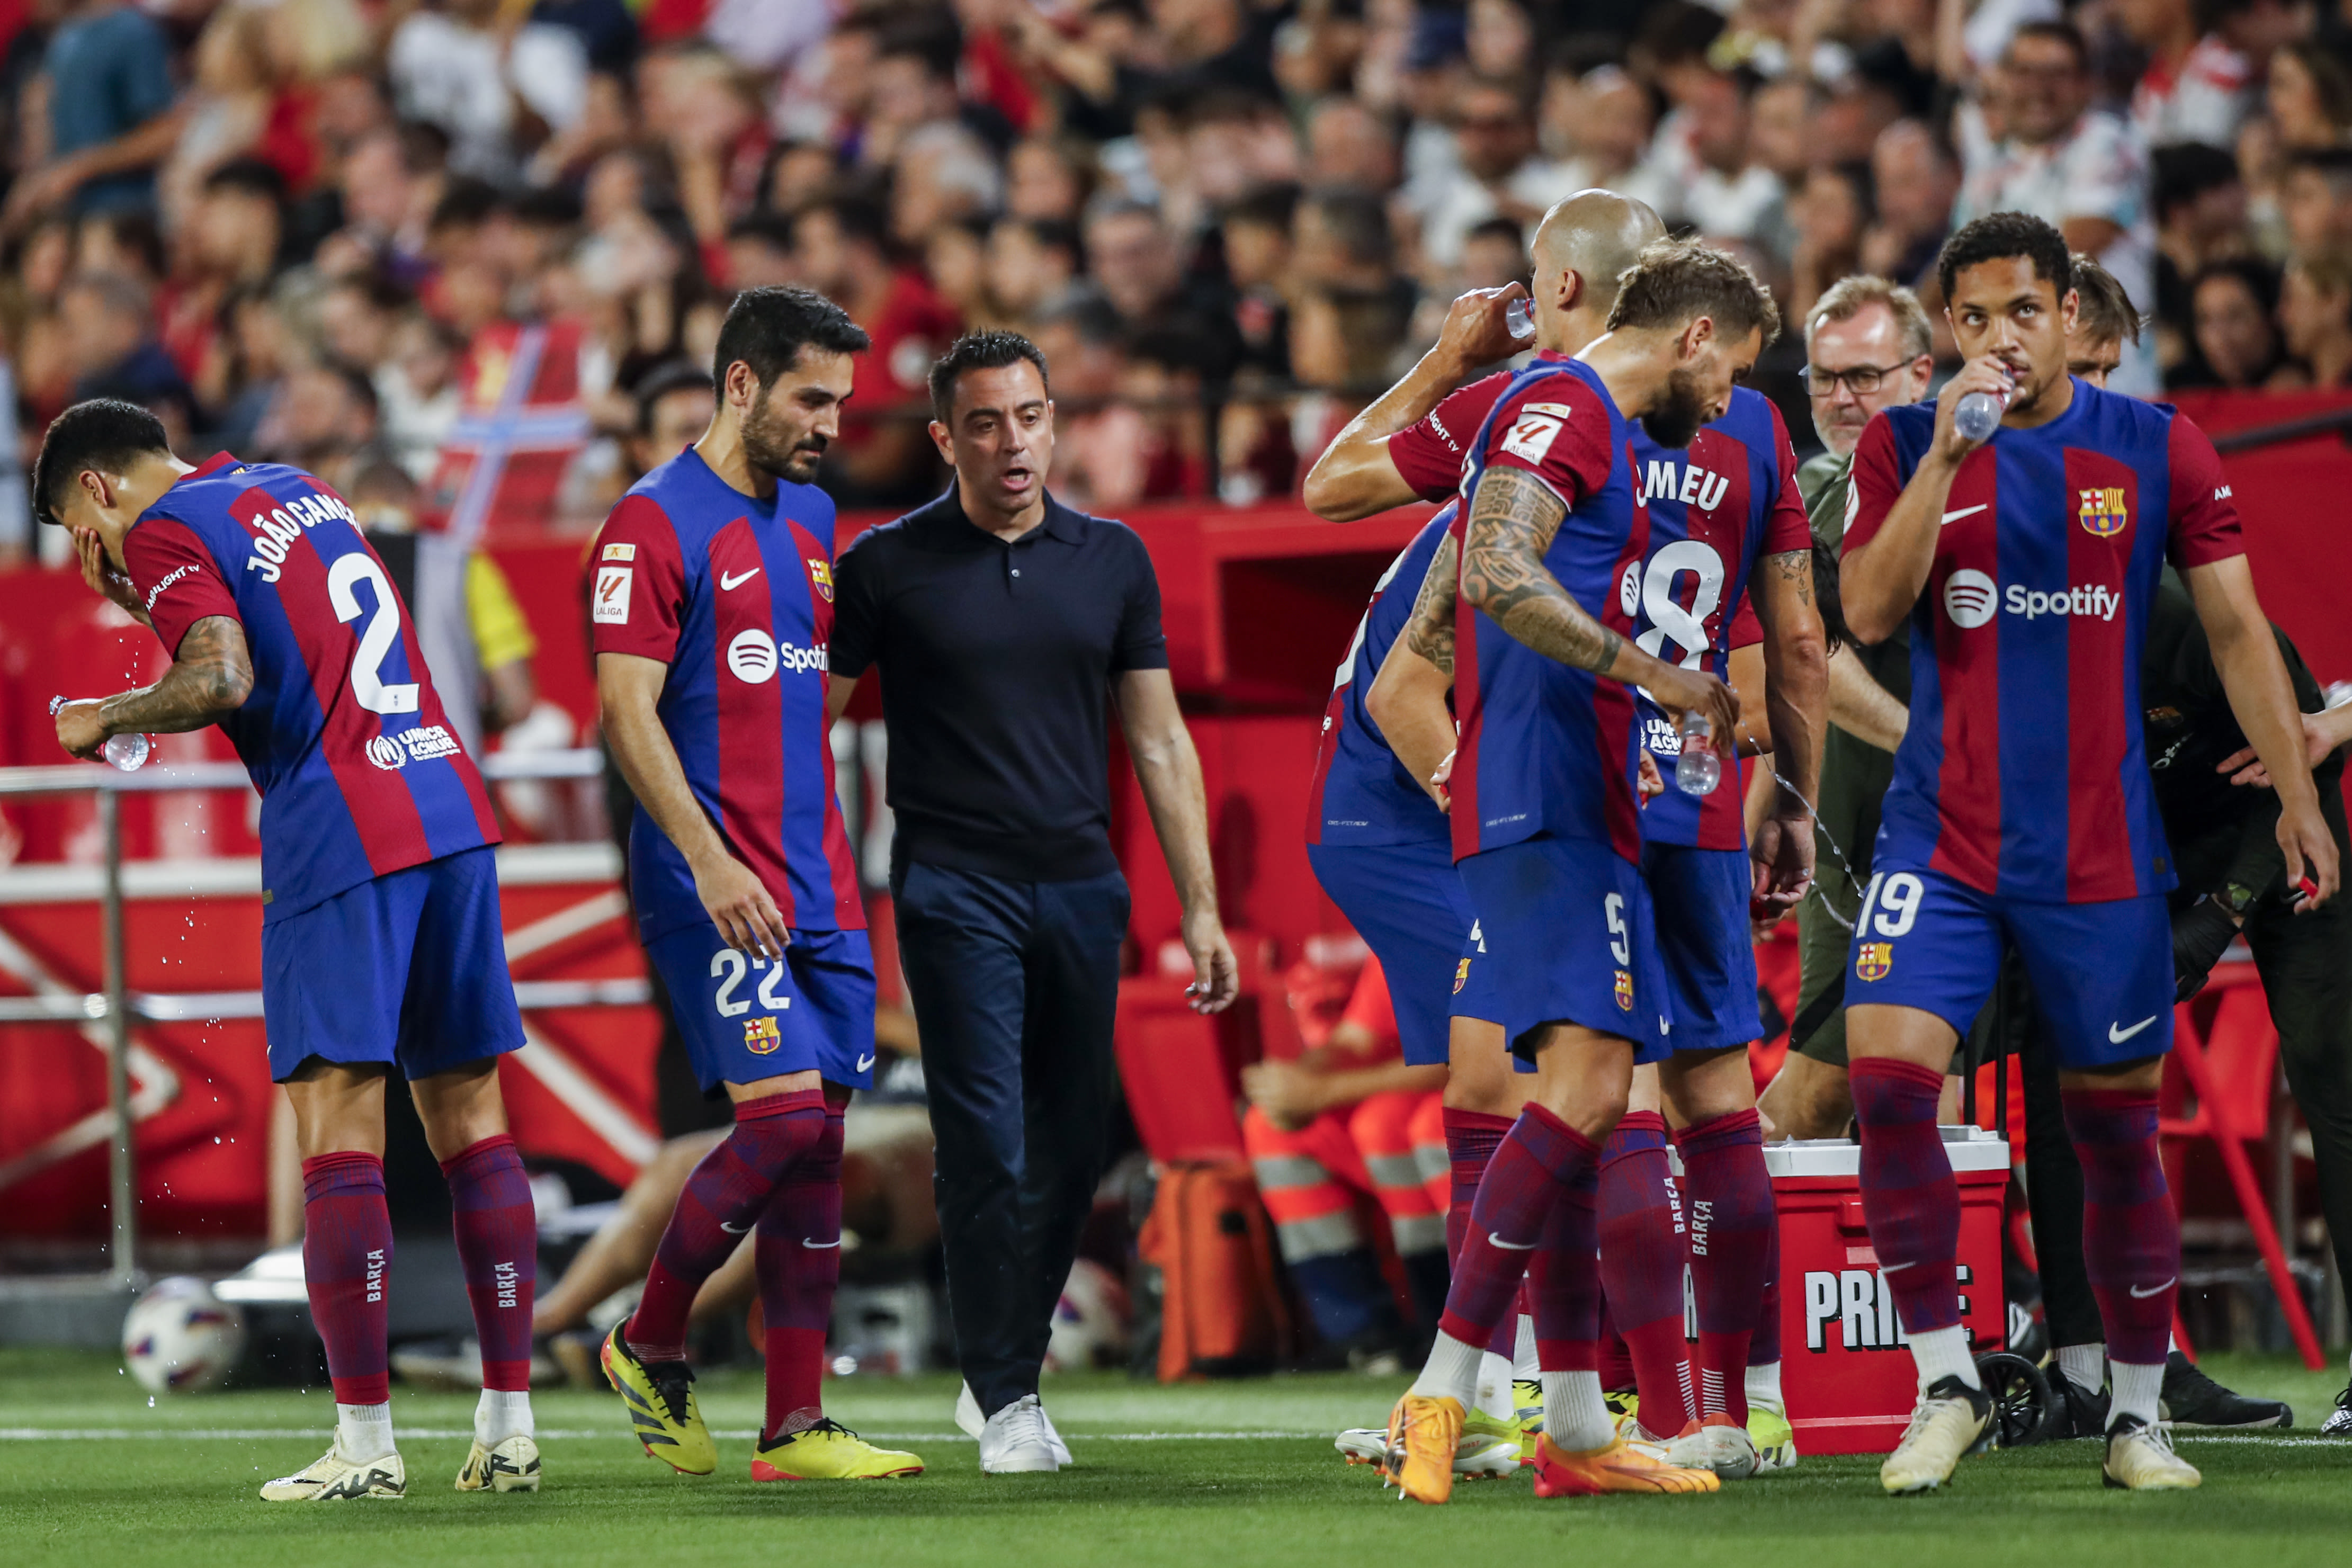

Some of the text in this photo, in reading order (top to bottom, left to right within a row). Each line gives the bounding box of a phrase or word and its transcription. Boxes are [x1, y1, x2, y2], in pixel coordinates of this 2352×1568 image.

[246, 513, 302, 584] JOÃO
[596, 607, 622, 616] LALIGA
[1635, 539, 1725, 703] 8
[2005, 584, 2121, 622] Spotify
[327, 552, 420, 715] 2
[397, 725, 449, 745] UNHCR
[408, 736, 458, 757] ACNUR
[1604, 892, 1631, 967] 5
[1855, 872, 1925, 938] 19
[710, 944, 791, 1018] 22
[1691, 1200, 1714, 1256] BARÇA
[366, 1248, 386, 1303] BARÇA
[494, 1261, 520, 1308] BARÇA
